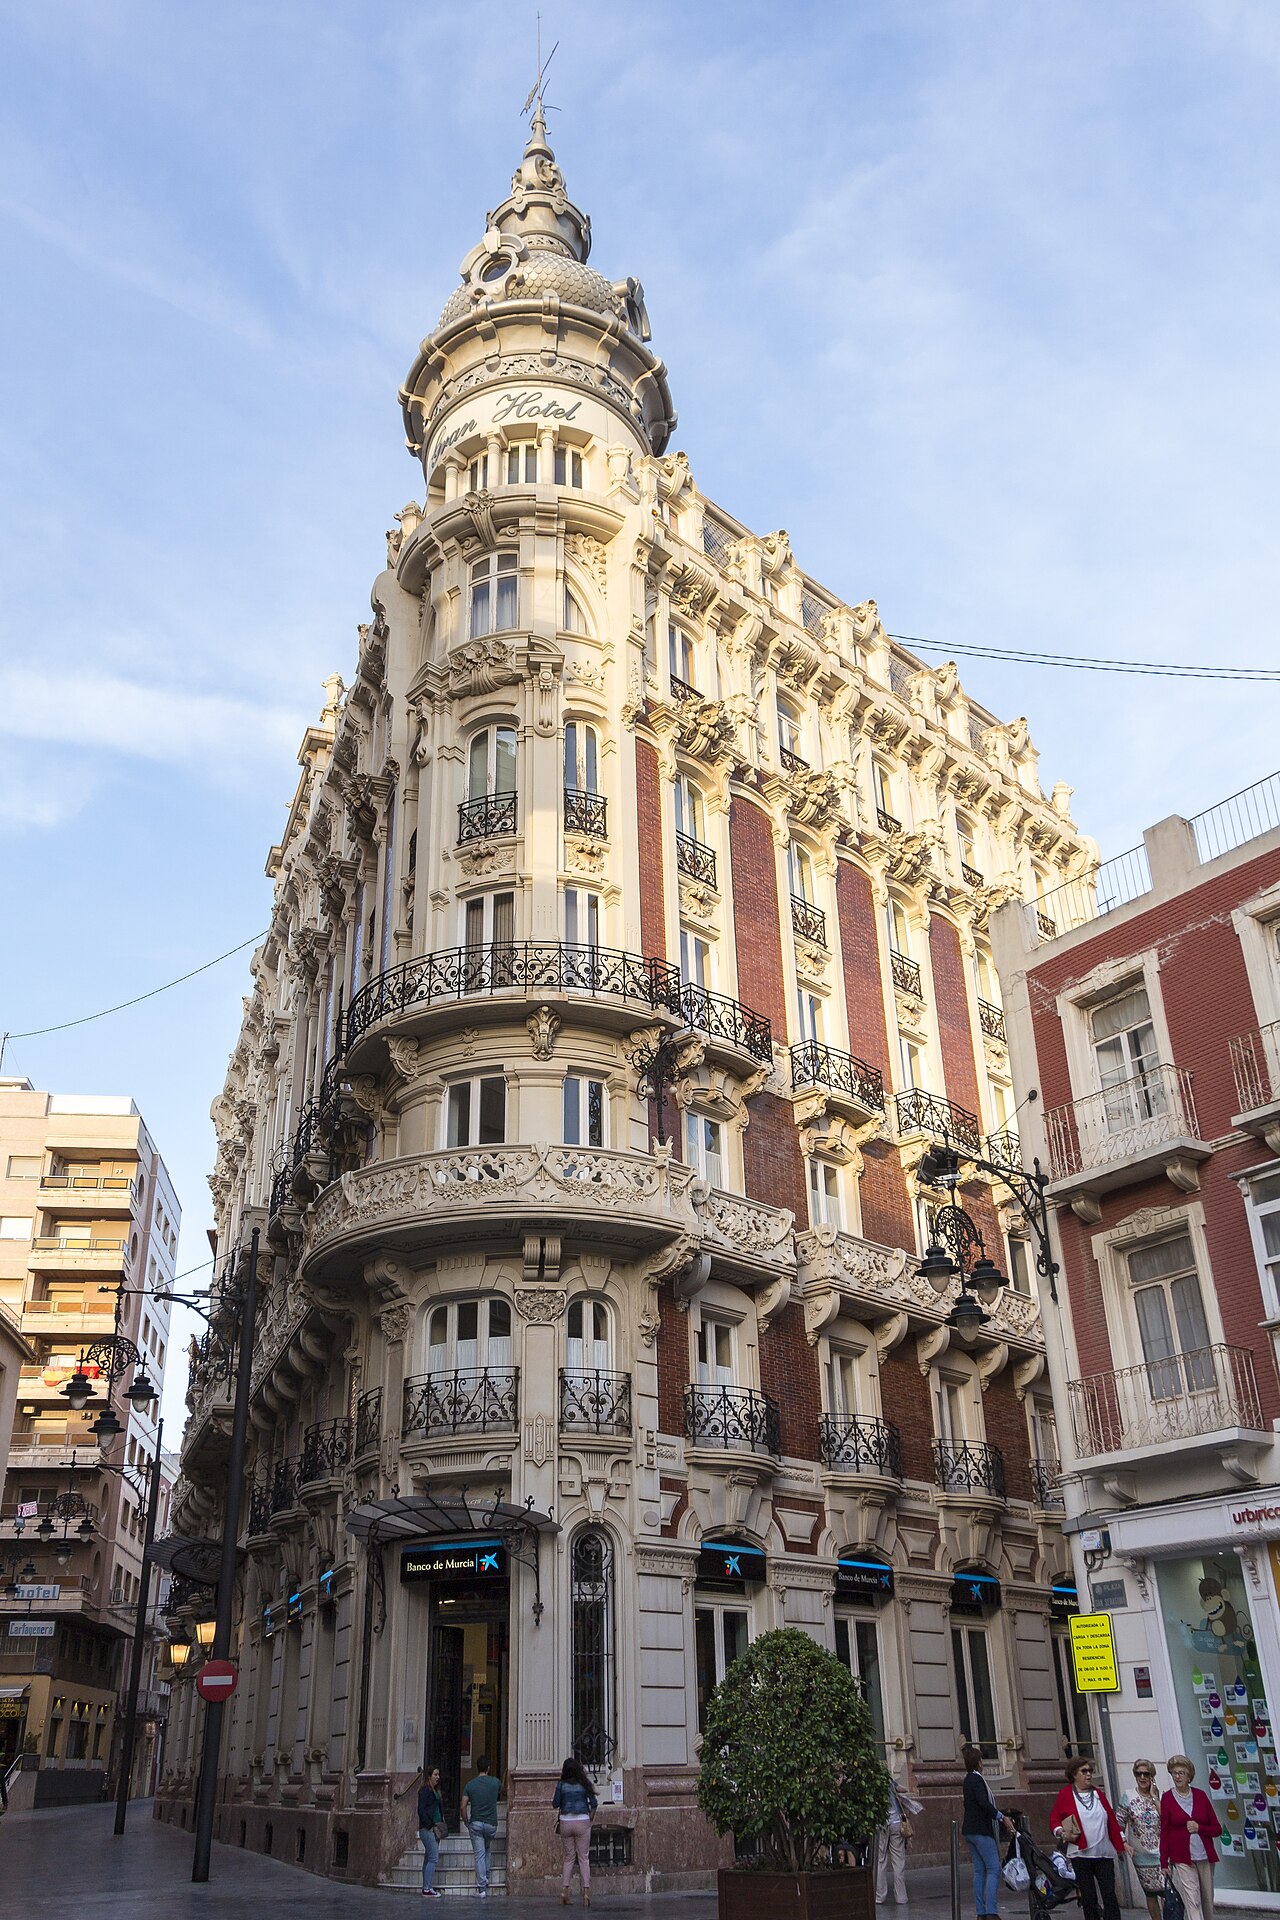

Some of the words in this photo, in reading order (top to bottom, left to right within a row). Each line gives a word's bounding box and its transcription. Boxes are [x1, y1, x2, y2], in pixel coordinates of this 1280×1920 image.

[491, 391, 582, 423] Hotel
[406, 1562, 432, 1572] Banco
[433, 1560, 444, 1570] de
[445, 1559, 475, 1569] Murcia
[838, 1571, 853, 1581] Banco
[854, 1573, 860, 1583] de
[861, 1575, 878, 1584] Murcia
[16, 1586, 56, 1599] hotel
